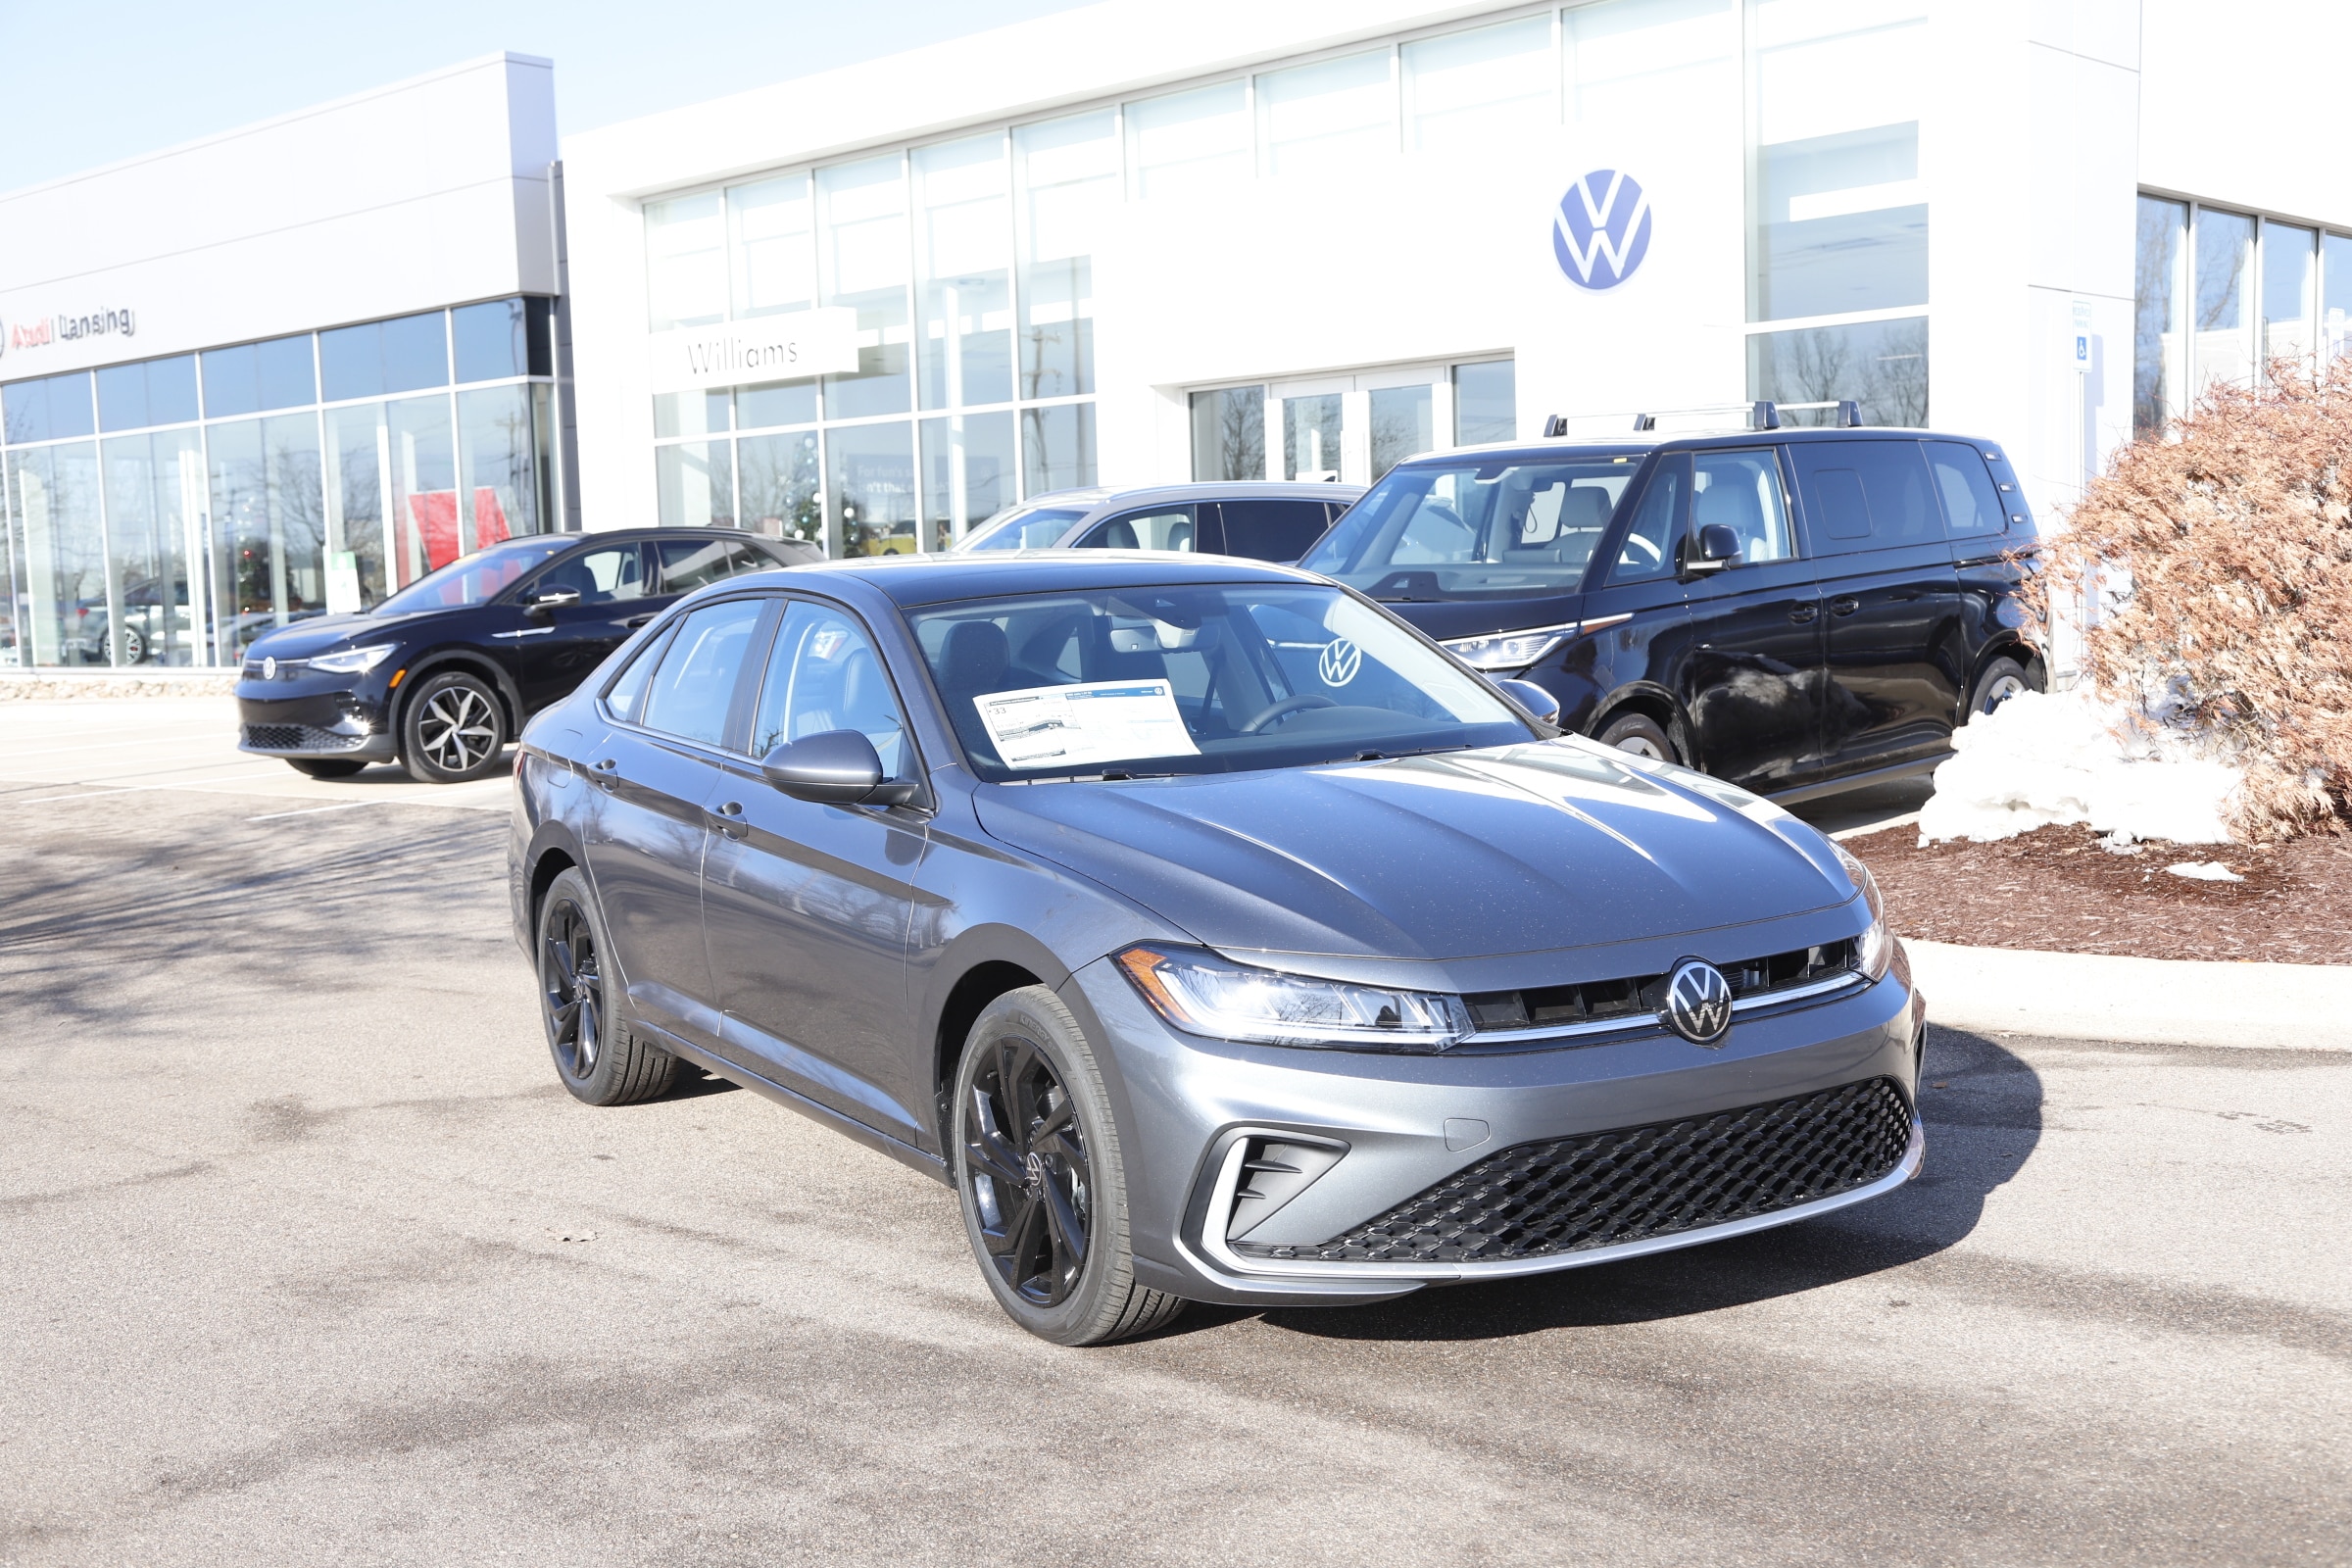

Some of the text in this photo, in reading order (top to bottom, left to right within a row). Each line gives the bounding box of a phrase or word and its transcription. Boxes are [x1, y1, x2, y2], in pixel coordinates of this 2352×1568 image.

[1553, 169, 1652, 291] VW
[11, 306, 134, 349] Audi Lansing
[688, 336, 798, 374] Williams
